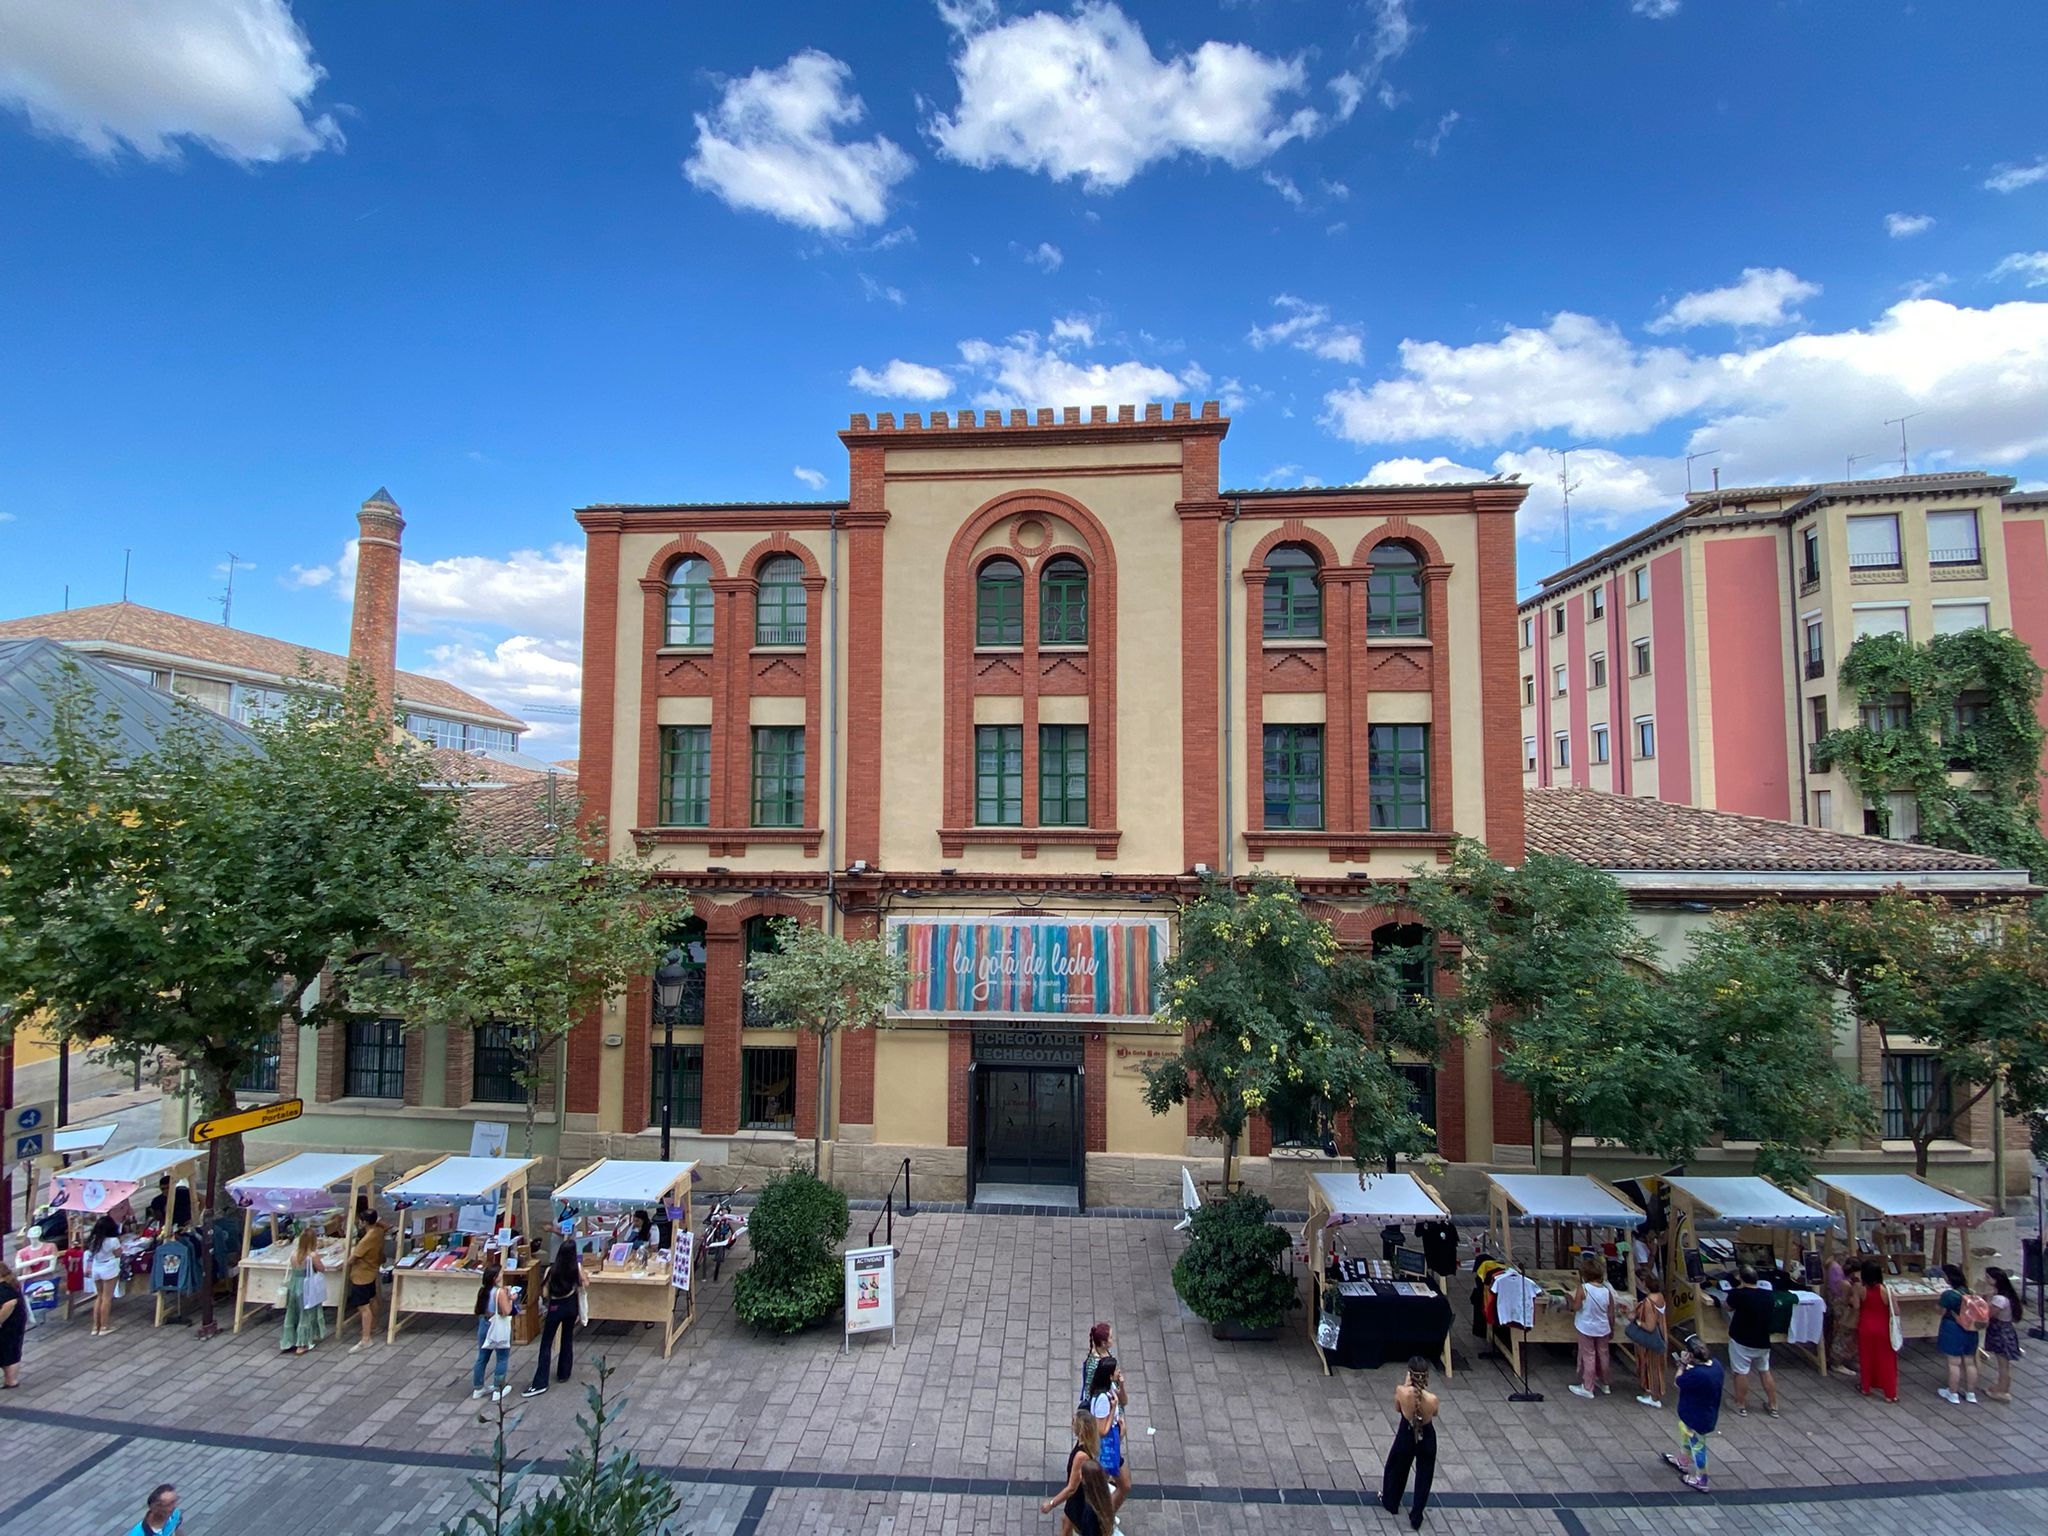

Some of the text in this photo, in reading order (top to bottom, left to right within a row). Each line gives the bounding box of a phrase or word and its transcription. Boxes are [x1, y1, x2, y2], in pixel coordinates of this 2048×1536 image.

[953, 941, 1100, 1001] la gota de leche
[266, 1106, 285, 1114] hotel
[261, 1109, 299, 1124] Portales
[856, 1256, 883, 1265] ACTIVIDAD
